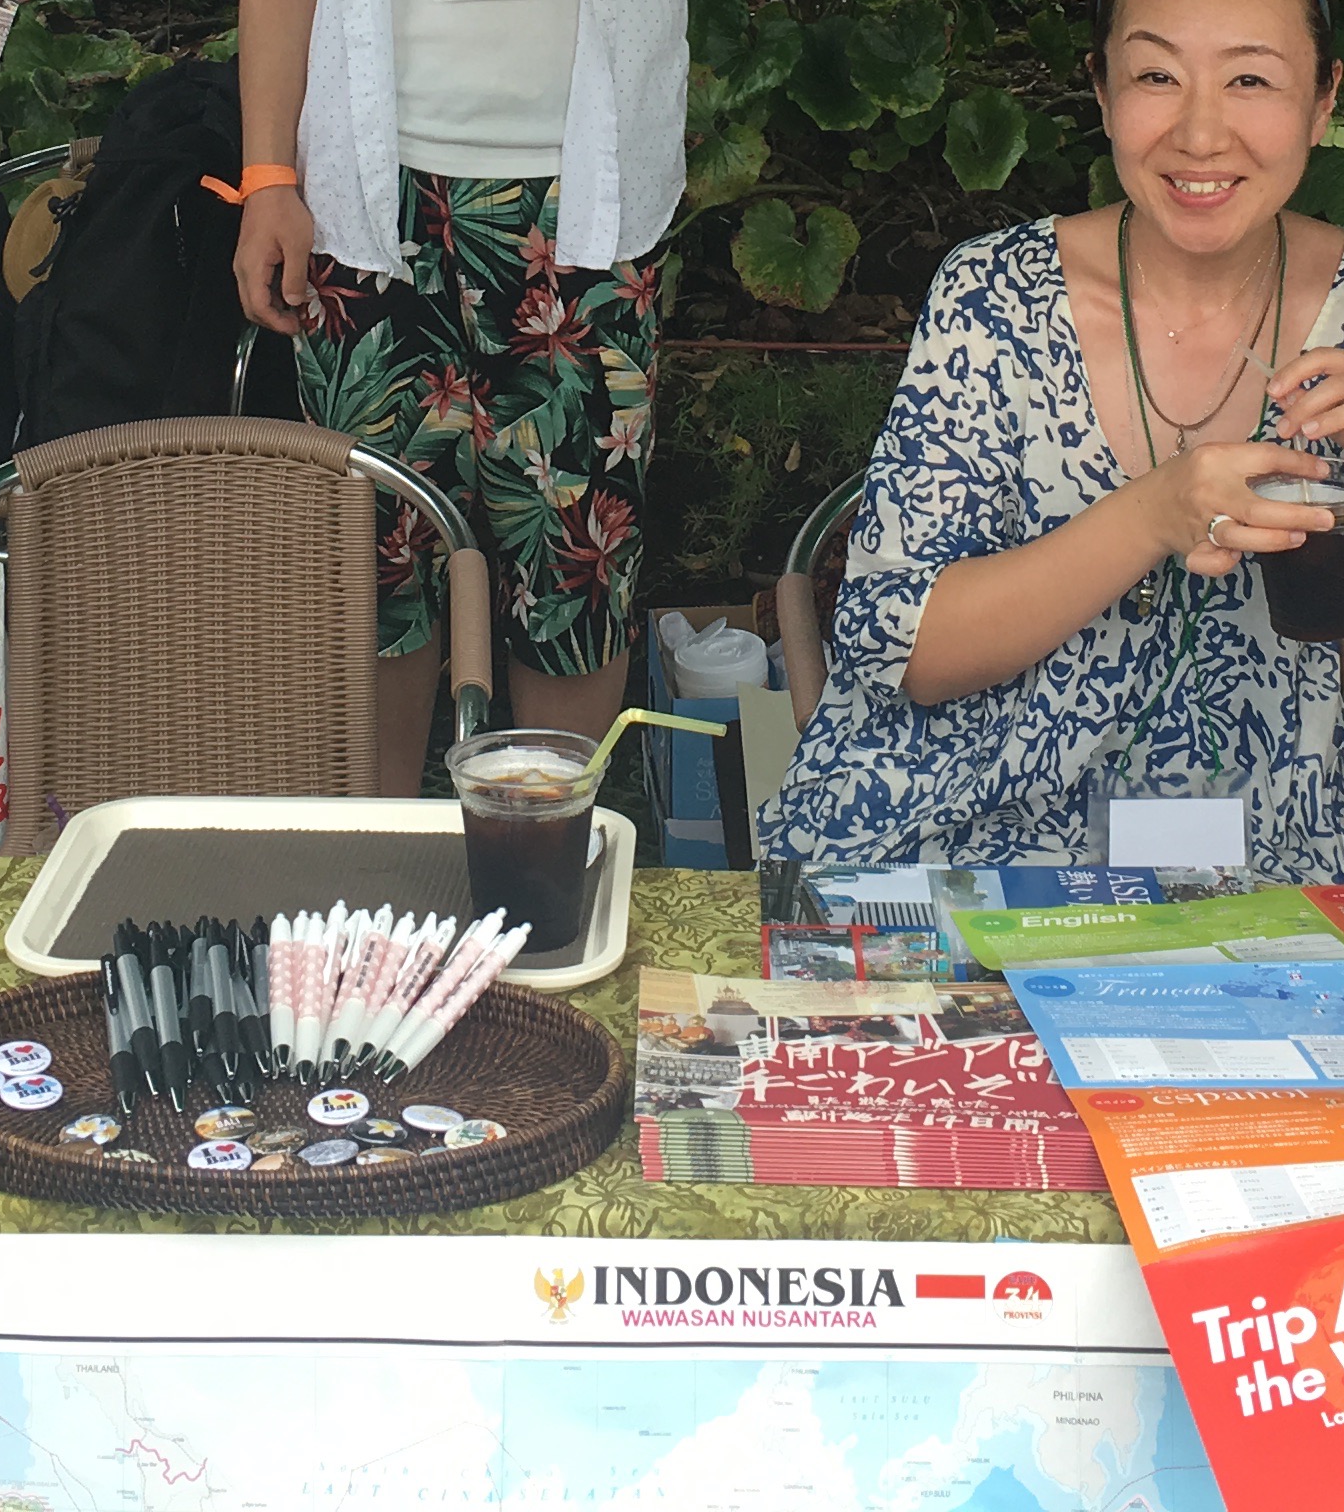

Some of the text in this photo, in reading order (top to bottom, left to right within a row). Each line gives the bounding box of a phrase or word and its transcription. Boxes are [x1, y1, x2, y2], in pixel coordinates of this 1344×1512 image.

[1021, 911, 1137, 929] English
[9, 1051, 42, 1067] Bali
[735, 1034, 1050, 1071] 東南アジアは
[18, 1084, 53, 1100] Bali
[734, 1067, 1037, 1102] 手ごわいぞ
[323, 1100, 359, 1114] Bali
[206, 1150, 241, 1166] Bali
[593, 1265, 906, 1309] INDONESIA
[621, 1309, 878, 1329] WAWASAN NUSANTARA
[1003, 1311, 1043, 1320] PROVINSI
[1191, 1296, 1317, 1365] Trip
[76, 1364, 121, 1374] THAILAND
[1235, 1360, 1326, 1417] the
